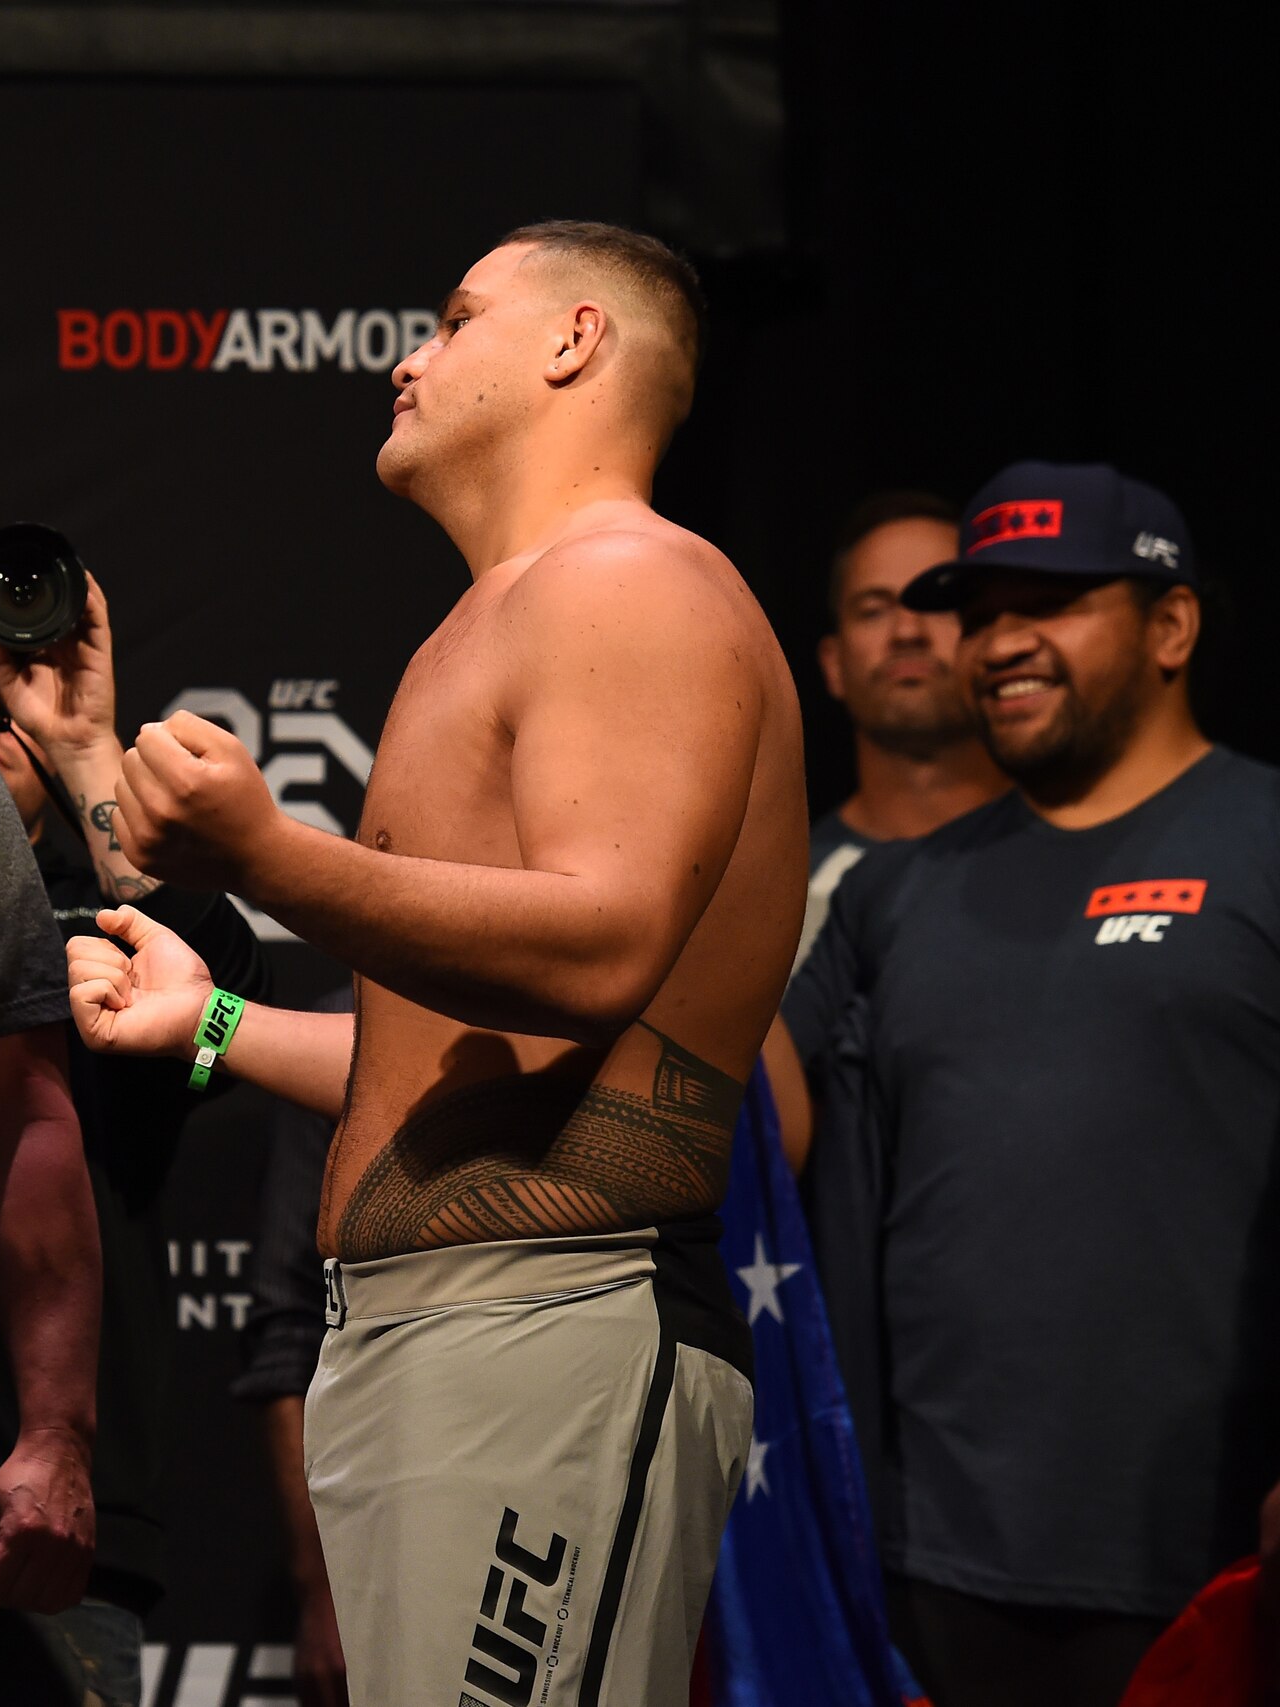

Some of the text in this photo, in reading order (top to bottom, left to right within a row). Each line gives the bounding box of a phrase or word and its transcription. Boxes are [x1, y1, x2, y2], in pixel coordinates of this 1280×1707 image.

[267, 678, 339, 709] UFC
[1094, 914, 1174, 946] UFC
[203, 998, 236, 1047] UFC
[464, 1506, 568, 1707] UFC
[540, 1546, 581, 1704] SUBMISSION KNOCKOUT TECHNICAL KNOCKOUT
